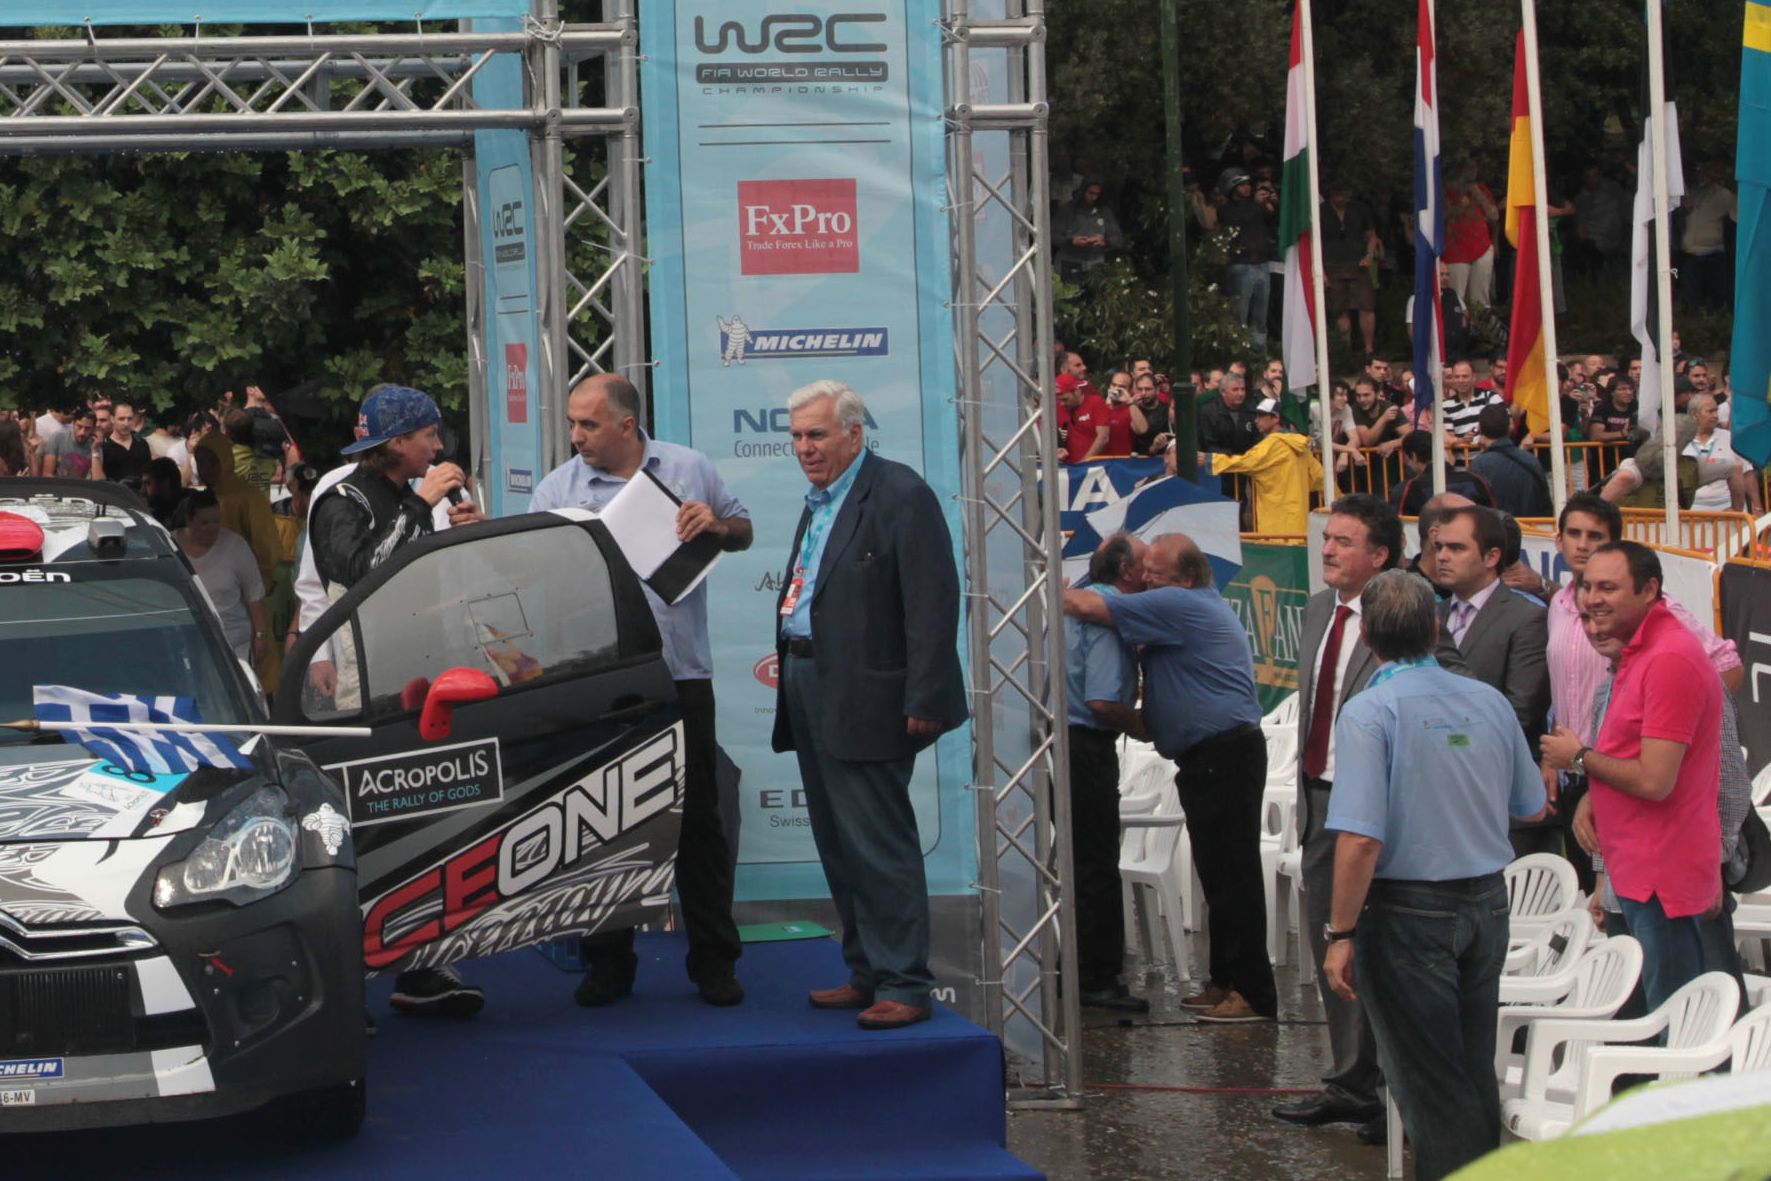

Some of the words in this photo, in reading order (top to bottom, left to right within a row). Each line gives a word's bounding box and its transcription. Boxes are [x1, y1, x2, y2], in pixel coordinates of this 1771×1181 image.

[694, 13, 888, 55] WRC
[701, 68, 731, 79] FIA
[737, 67, 808, 78] WORLD
[814, 67, 883, 77] RALLY
[702, 85, 884, 96] CHAMPIONSHIP
[744, 204, 852, 236] FxPro
[747, 240, 773, 250] Trade
[775, 239, 802, 250] Forex
[805, 239, 826, 249] Like
[836, 238, 853, 248] Pro
[753, 332, 884, 352] MICHELIN
[358, 750, 490, 798] ACROPOLIS
[366, 799, 391, 815] THE
[392, 792, 426, 811] RALLY
[429, 789, 446, 804] OF
[447, 783, 482, 801] GODS
